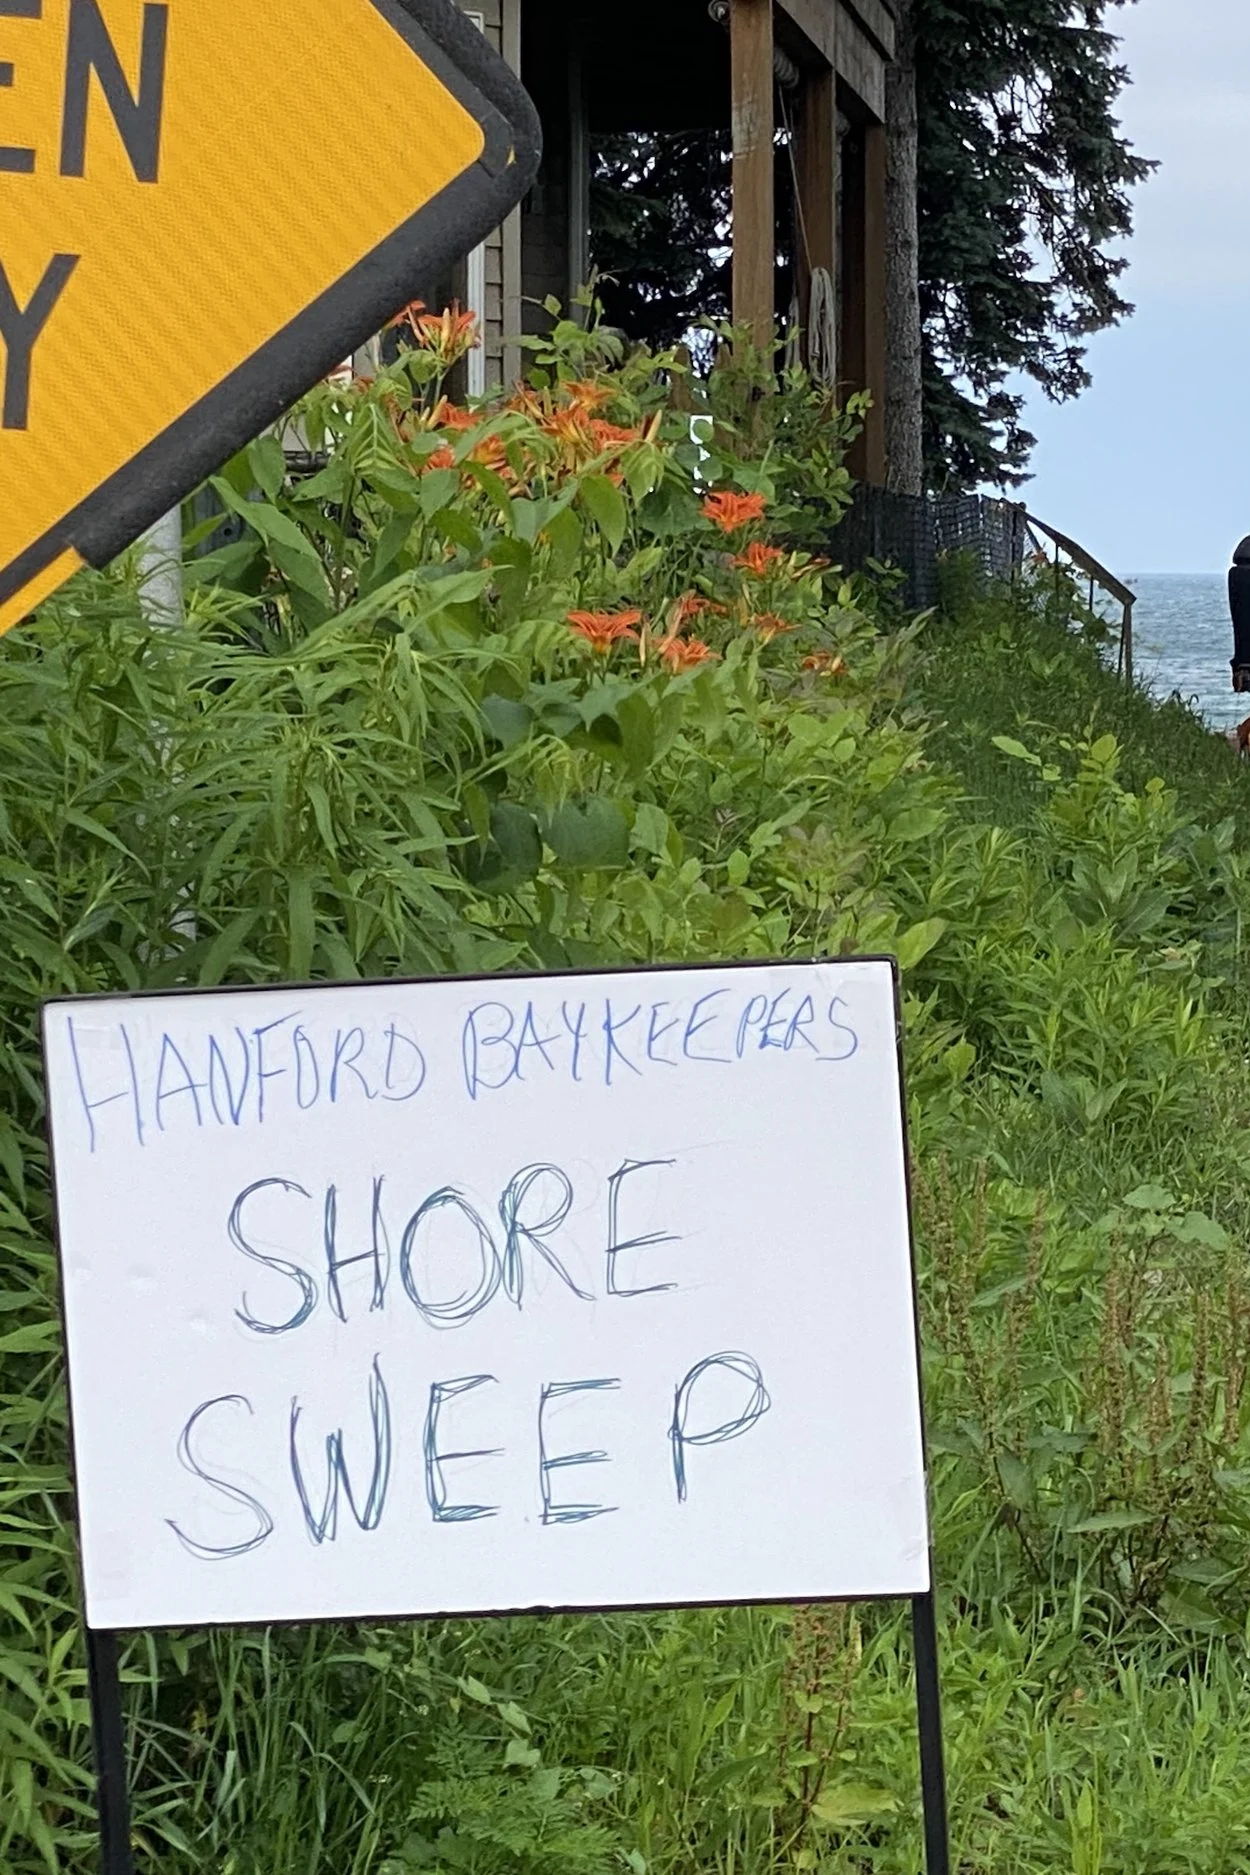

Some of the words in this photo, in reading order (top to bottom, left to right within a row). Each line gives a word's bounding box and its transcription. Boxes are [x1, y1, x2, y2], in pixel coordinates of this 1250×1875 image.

[66, 1008, 428, 1153] HANFORD
[226, 1158, 684, 1334] SHORE
[164, 1350, 772, 1562] SWEEP
